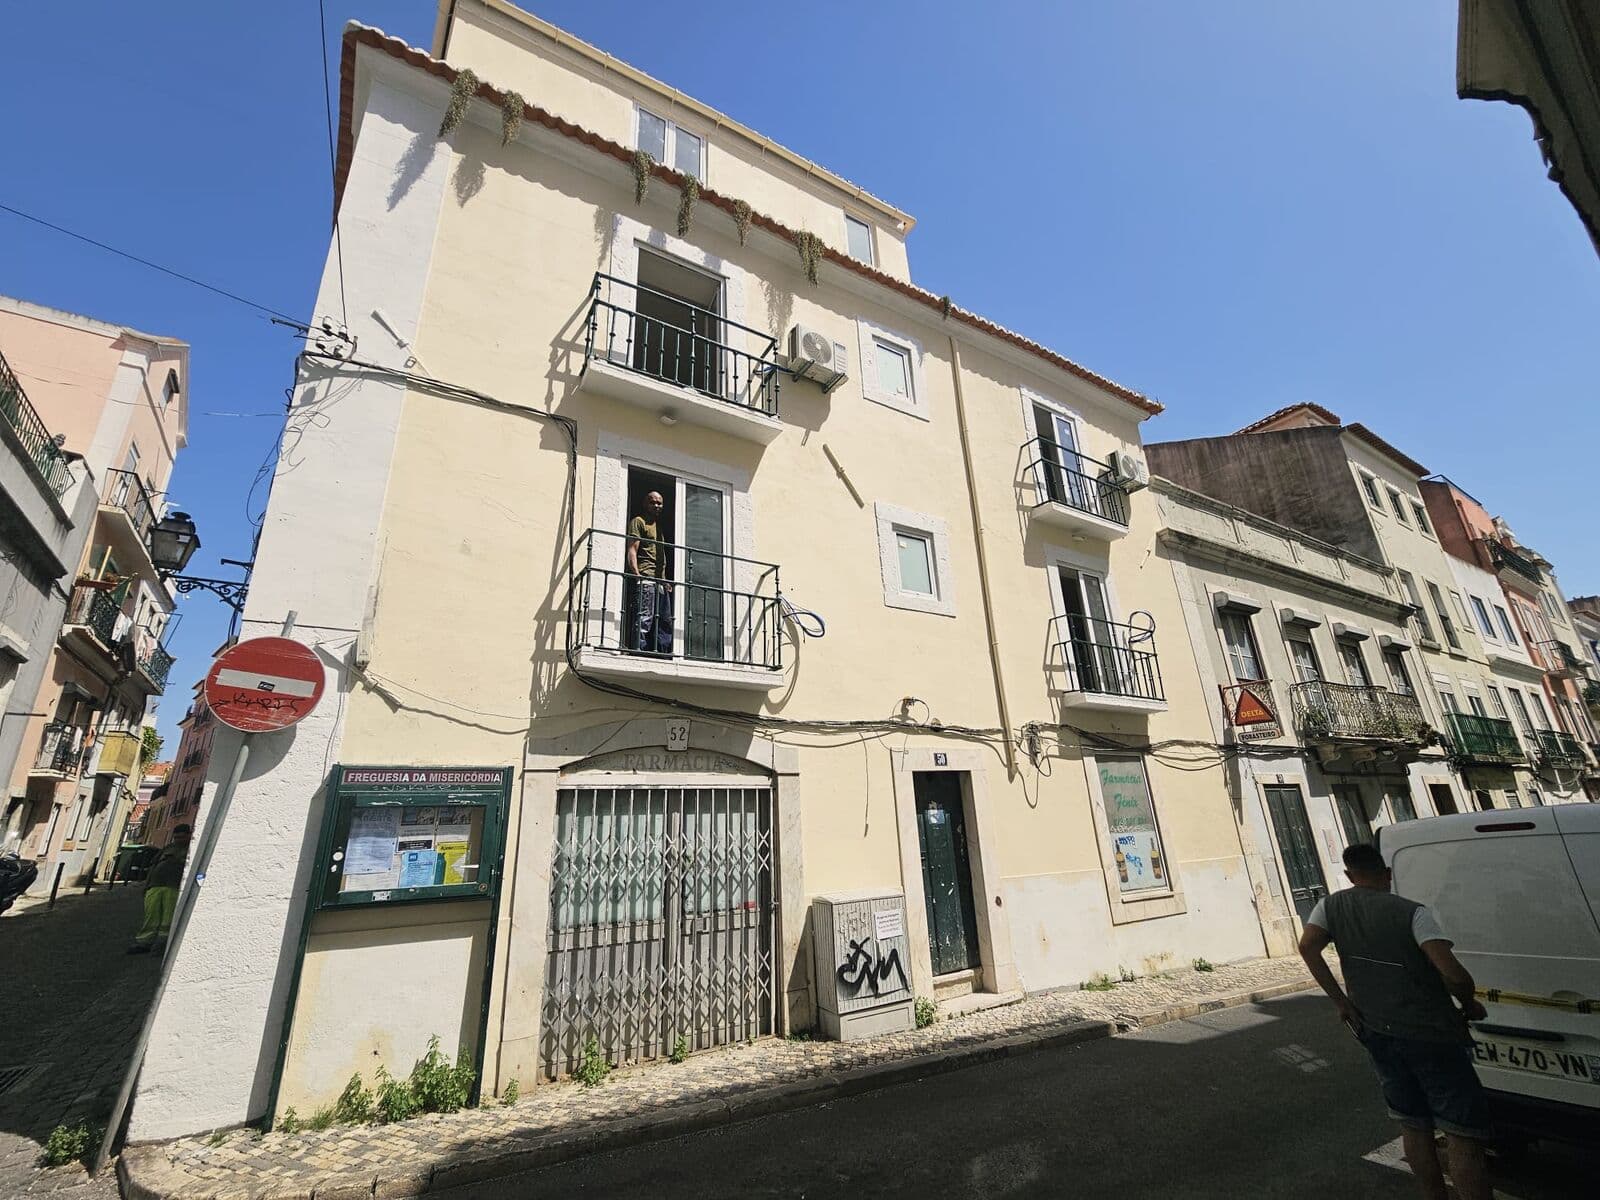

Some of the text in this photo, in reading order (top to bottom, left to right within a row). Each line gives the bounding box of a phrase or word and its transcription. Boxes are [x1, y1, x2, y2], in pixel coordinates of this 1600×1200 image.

[1241, 710, 1265, 718] DELTA
[670, 726, 686, 741] 52
[623, 753, 723, 772] FARMACIA
[348, 770, 500, 783] FREGUESIA DA MISERICÓRDIA
